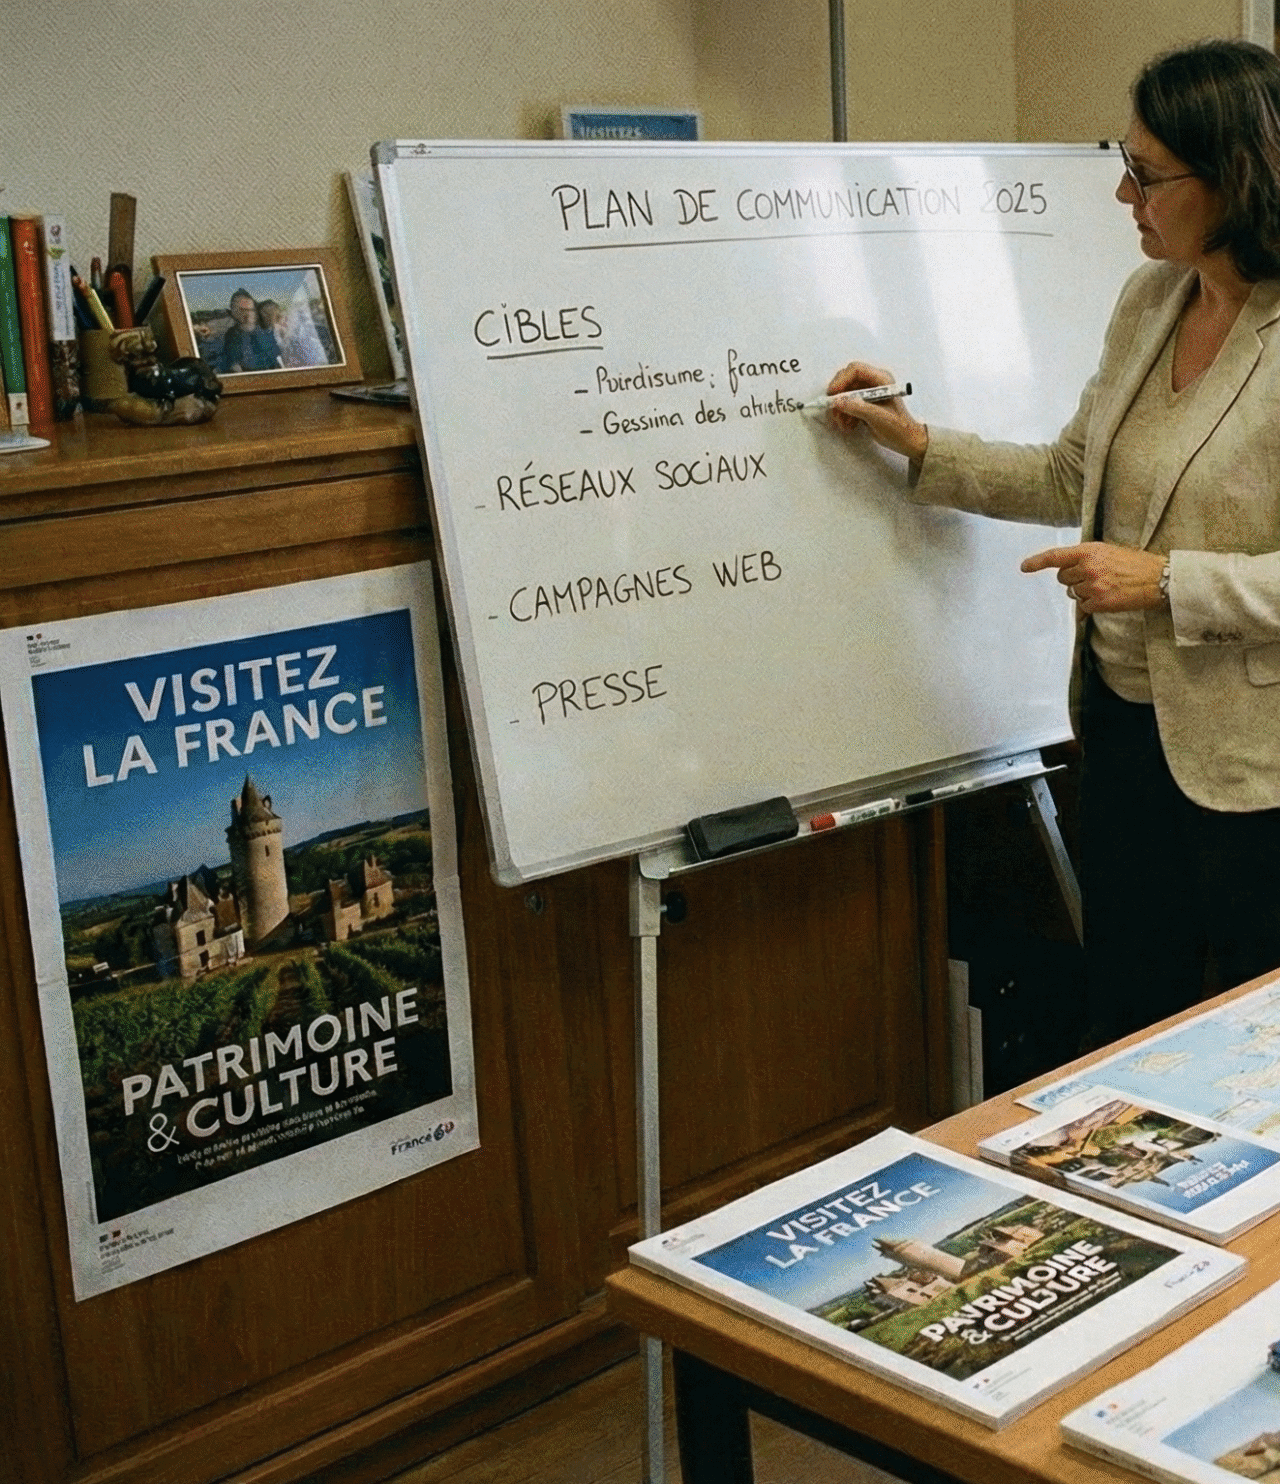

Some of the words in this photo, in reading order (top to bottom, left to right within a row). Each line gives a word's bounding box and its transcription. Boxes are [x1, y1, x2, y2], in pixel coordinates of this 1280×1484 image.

[551, 183, 654, 231] PLAN
[674, 188, 719, 225] DE
[980, 180, 1047, 215] 2025
[695, 399, 727, 424] des
[496, 460, 637, 511] RÉSEAUX
[509, 564, 693, 622] CAMPAGNES
[712, 550, 783, 588] WEB
[124, 644, 340, 723] VISITEZ
[531, 663, 668, 726] PRESSE
[83, 734, 158, 788] LA
[174, 685, 388, 768] FRANCE
[121, 986, 419, 1117] PATRIMOINE
[146, 1112, 181, 1153] &
[186, 1036, 399, 1138] CULTURE
[765, 1181, 892, 1242] VISITEZ
[765, 1244, 820, 1269] LA
[813, 1181, 941, 1246] FRANCE
